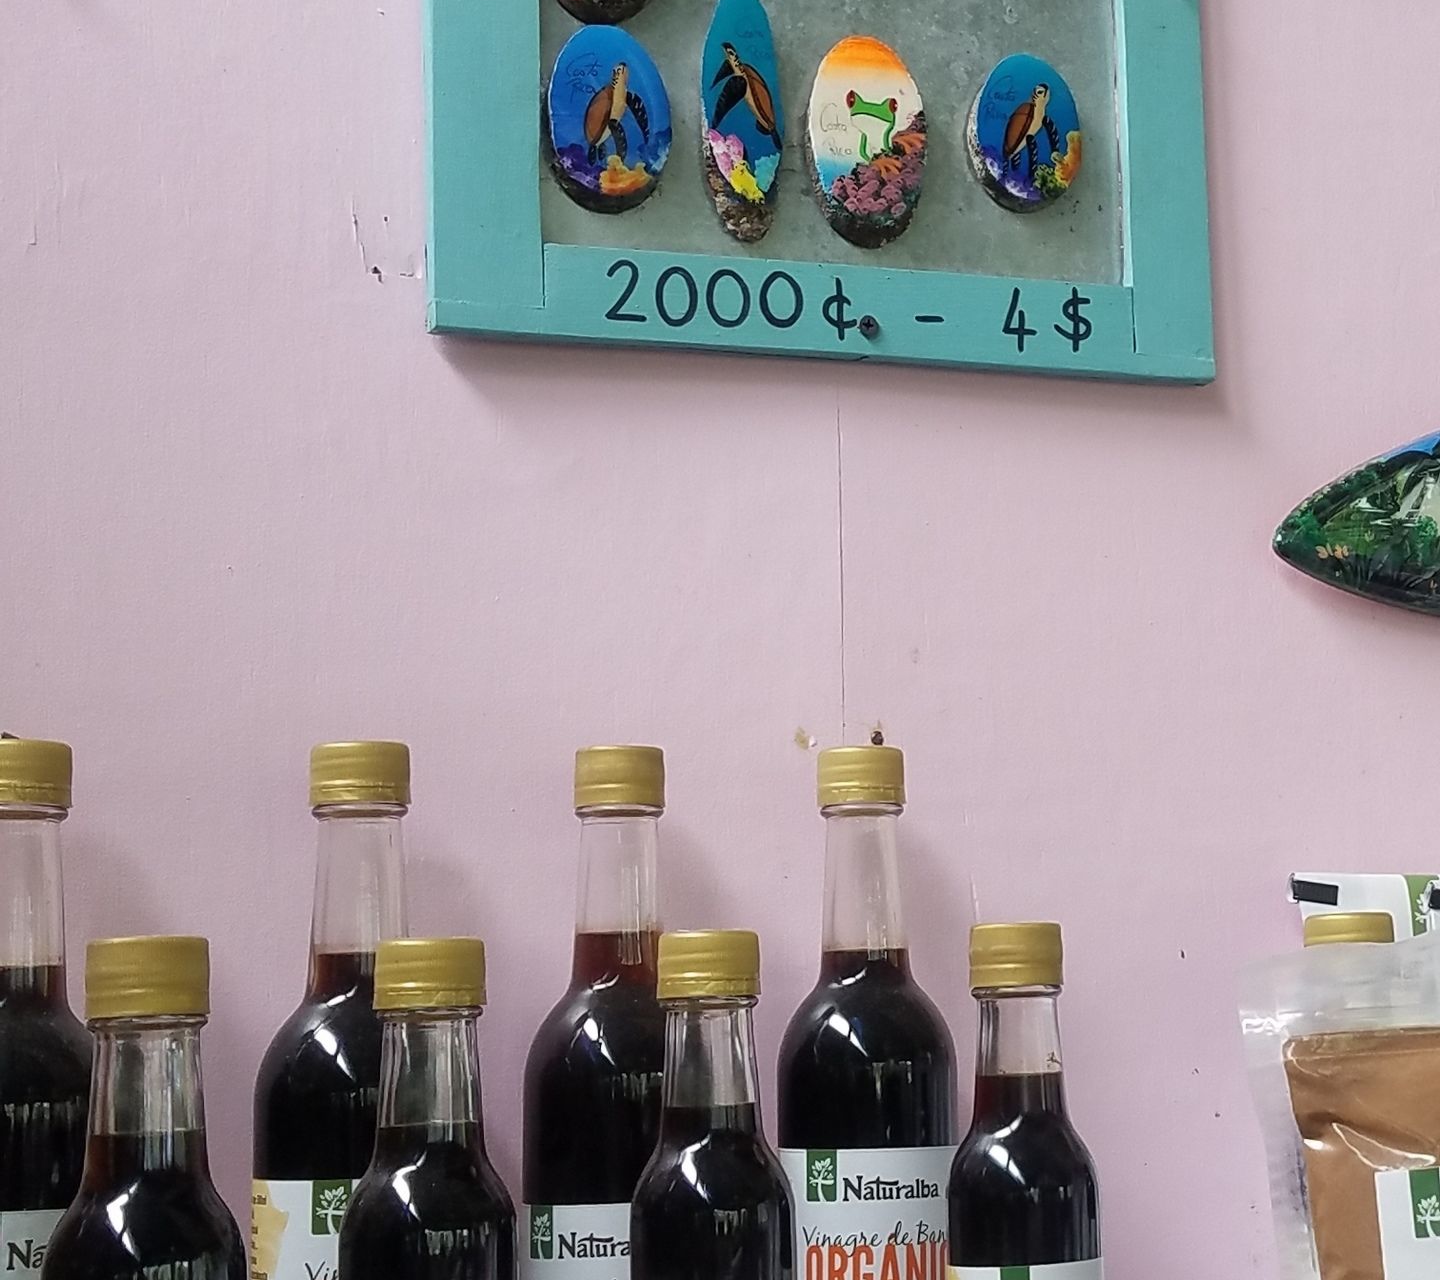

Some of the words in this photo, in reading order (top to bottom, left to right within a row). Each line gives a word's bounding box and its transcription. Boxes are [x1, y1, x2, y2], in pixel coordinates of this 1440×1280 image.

[842, 1175, 940, 1202] Naturalba
[558, 1231, 631, 1260] Natura
[802, 1225, 882, 1258] Vinagre
[889, 1219, 913, 1247] de
[916, 1219, 947, 1244] Ban
